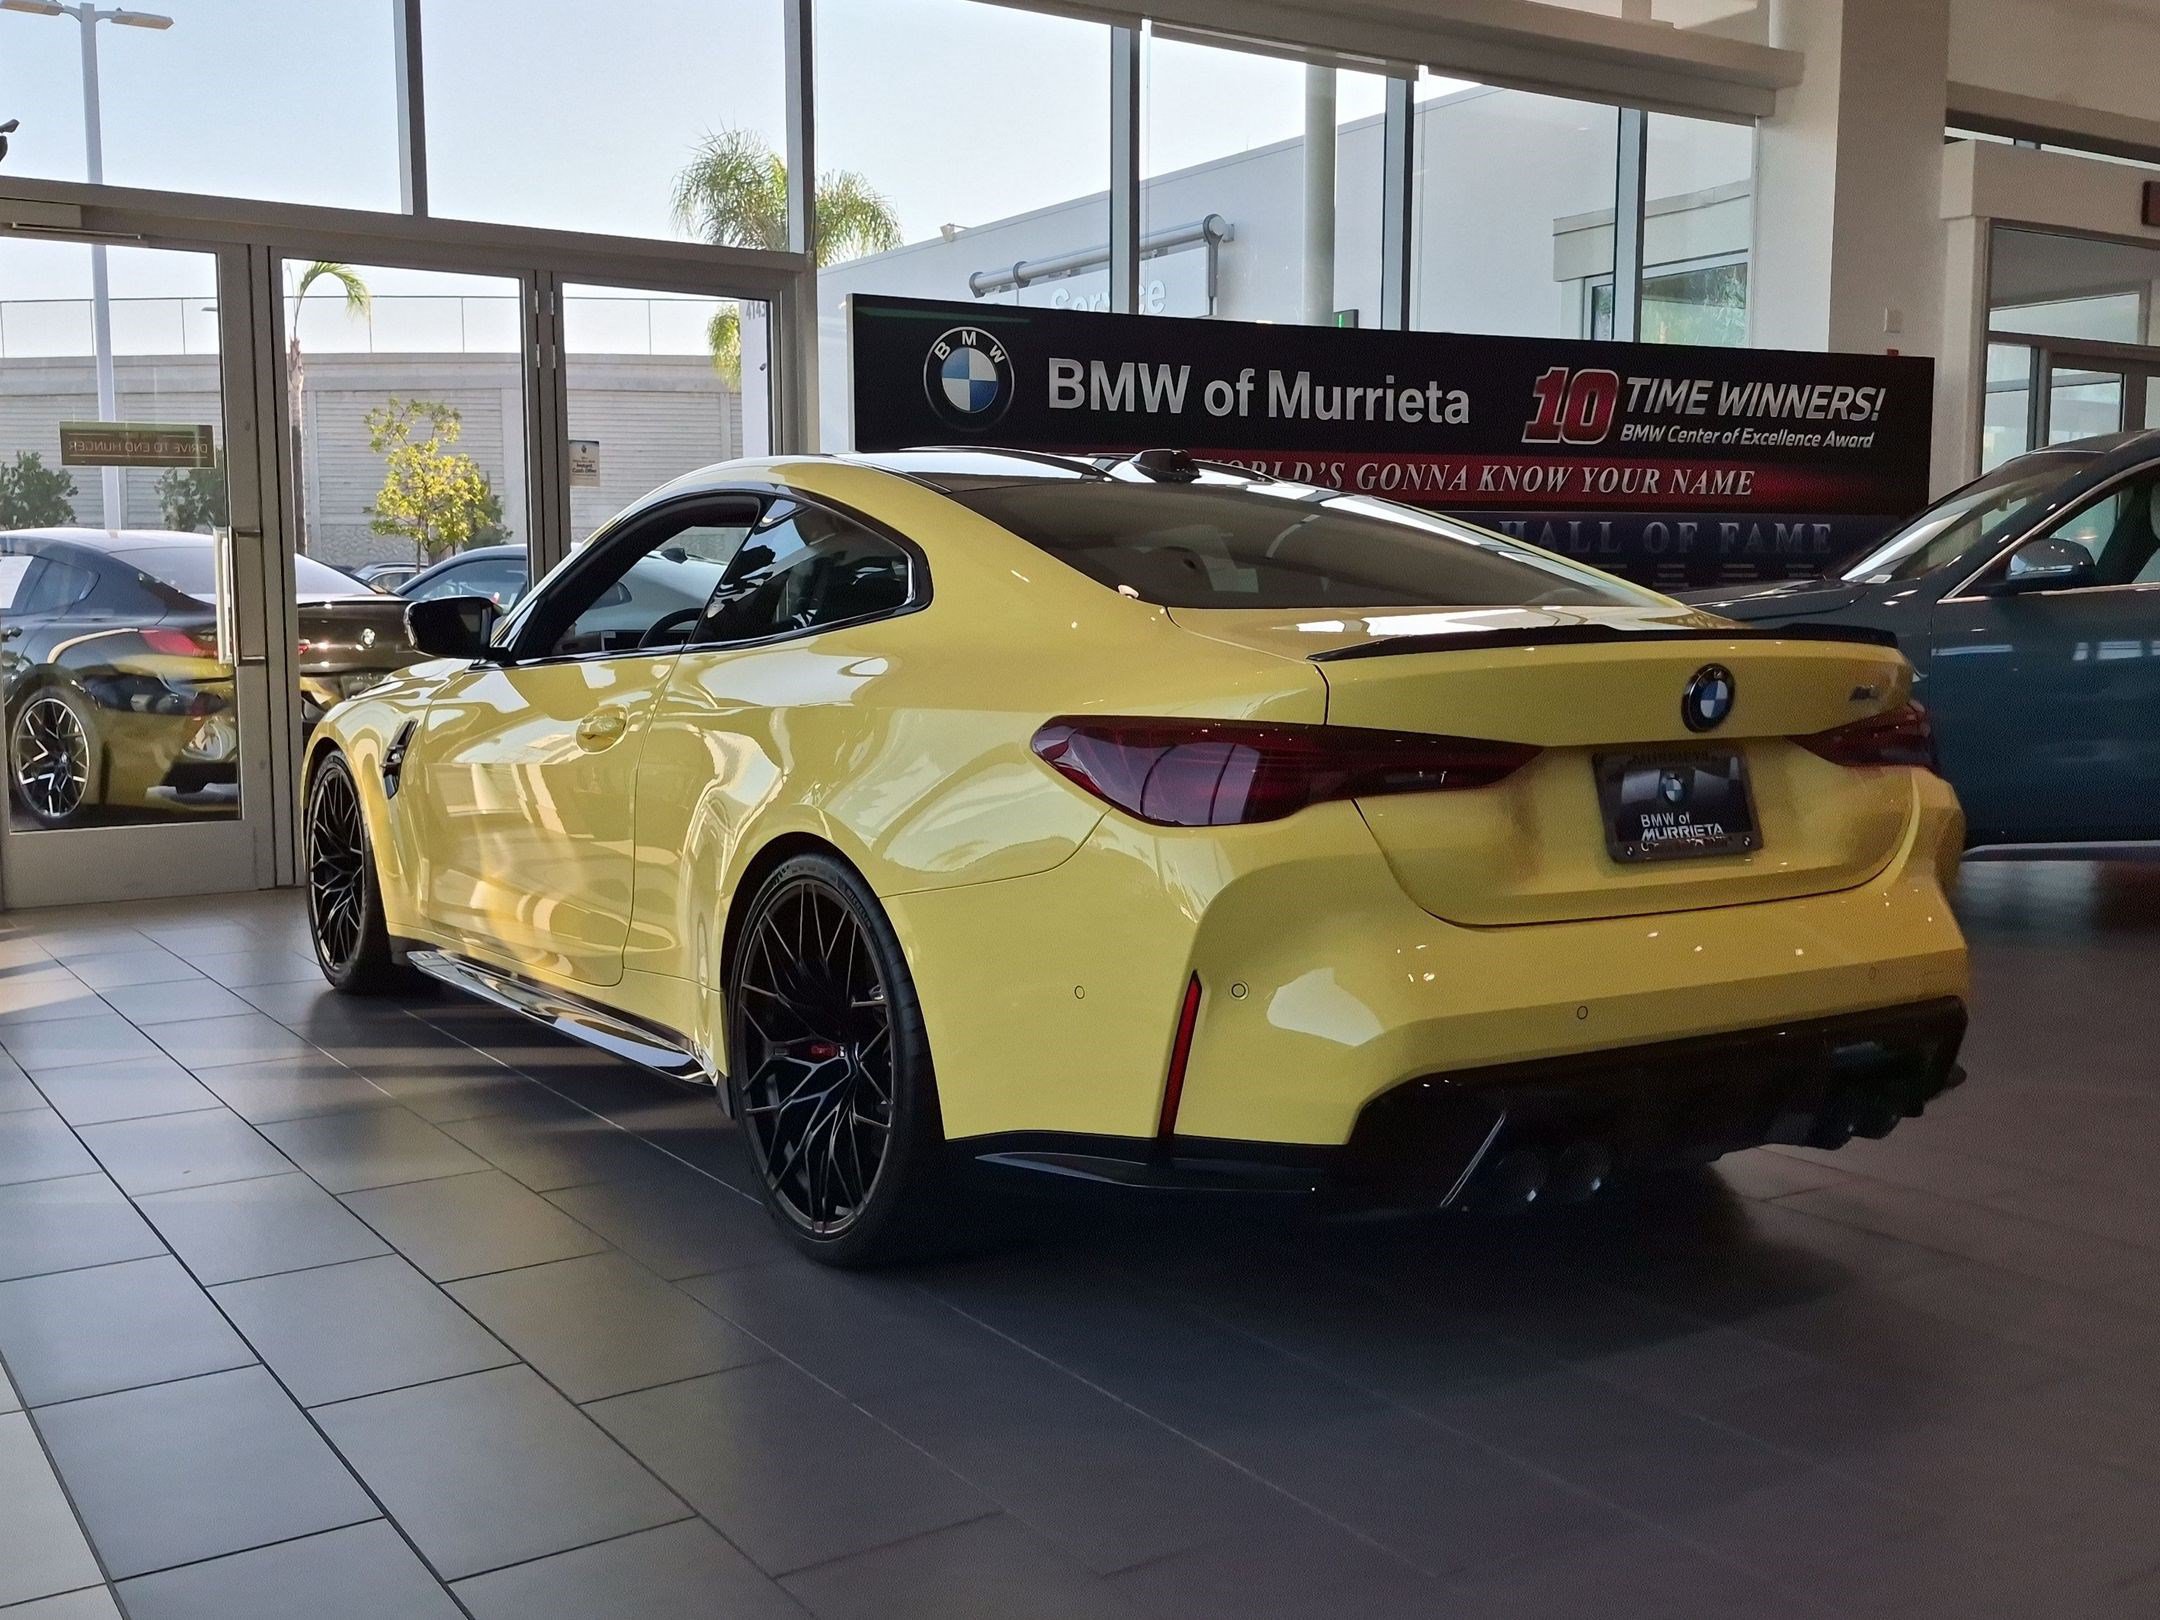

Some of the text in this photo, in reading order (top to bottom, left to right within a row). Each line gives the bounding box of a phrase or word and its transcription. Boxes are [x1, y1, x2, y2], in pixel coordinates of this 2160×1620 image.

[934, 331, 1006, 364] BMW
[1048, 357, 1470, 425] BMW of Murrieta
[1521, 366, 1887, 446] 10 TIME WINNERS!
[1620, 424, 1875, 448] BMW Center of Excellence Award
[1356, 463, 1467, 492] GONNA
[1477, 465, 1574, 493] KNOW
[1580, 466, 1661, 494] YOUR
[1668, 469, 1756, 495] NAME
[1498, 520, 1833, 555] HALL OF FAME
[1640, 812, 1674, 828] BMW
[1641, 822, 1725, 841] MURRIETA
